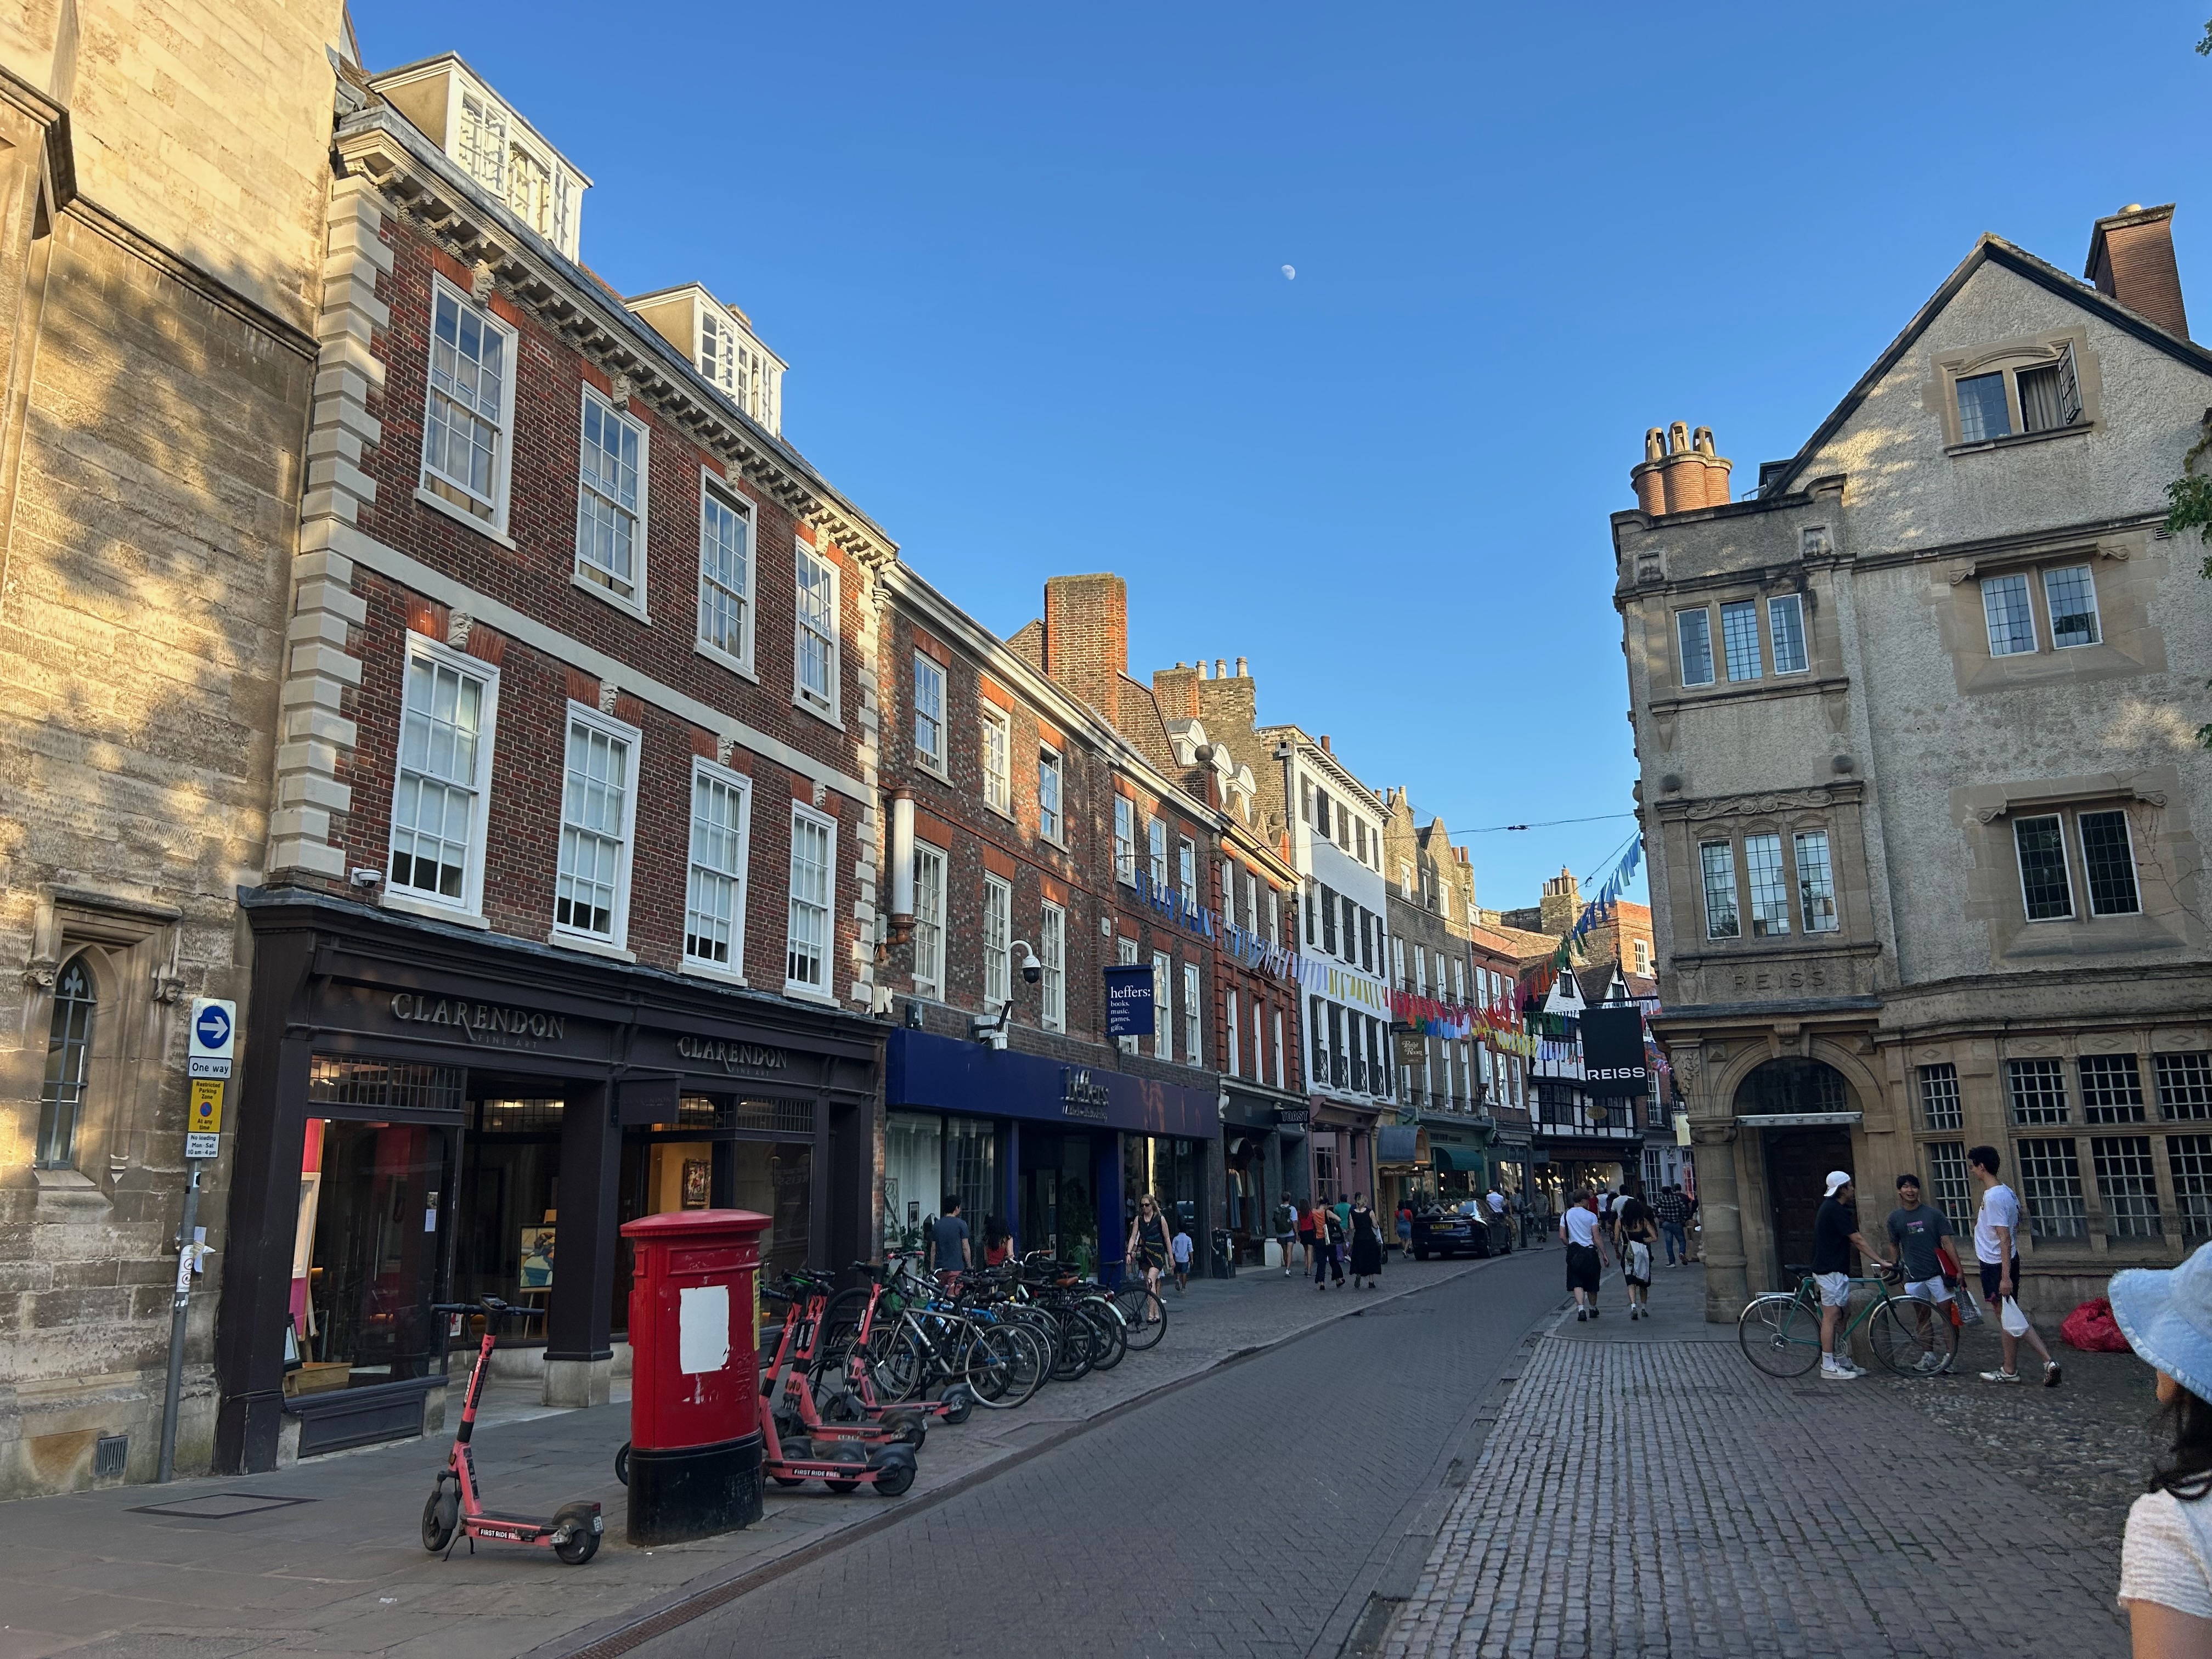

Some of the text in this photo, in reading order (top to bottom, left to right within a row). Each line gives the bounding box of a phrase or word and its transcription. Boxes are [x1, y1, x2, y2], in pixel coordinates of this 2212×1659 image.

[1732, 971, 1825, 990] REISS
[1110, 985, 1151, 998] heffers:
[391, 993, 566, 1041] CLARENDON
[1110, 1023, 1125, 1032] gifts.
[478, 1034, 538, 1049] FINE ART
[676, 1036, 787, 1073] CLARENDON
[1404, 1048, 1423, 1057] Room
[192, 1062, 229, 1075] One way
[731, 1066, 751, 1076] FINE
[1587, 1066, 1646, 1081] REISS
[1280, 1110, 1308, 1122] TOAST
[481, 1528, 495, 1537] FIRST
[495, 1530, 508, 1539] RIDE
